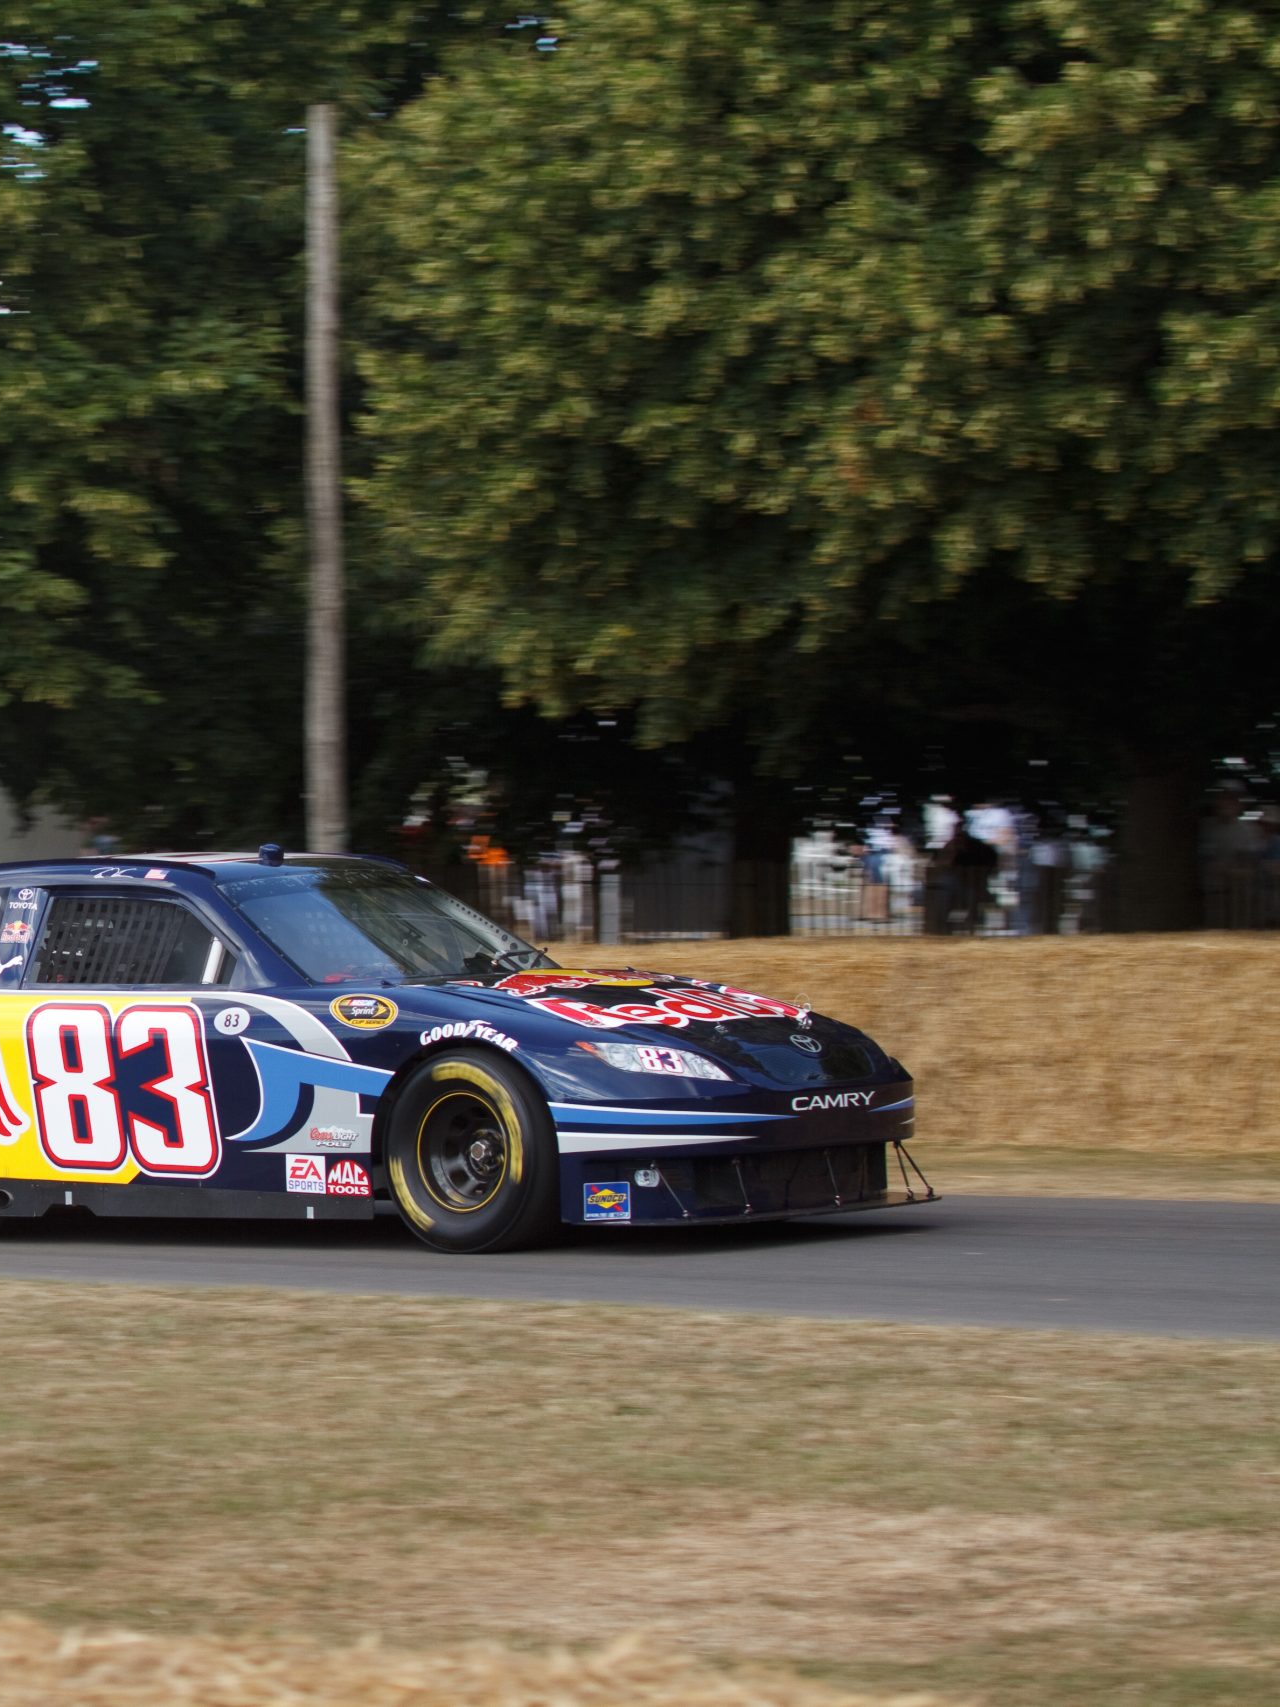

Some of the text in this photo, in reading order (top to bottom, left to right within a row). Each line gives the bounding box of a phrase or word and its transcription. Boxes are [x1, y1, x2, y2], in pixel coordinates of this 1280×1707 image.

[9, 902, 37, 910] TOYOTA
[351, 1007, 375, 1016] Sprint
[224, 1014, 240, 1028] 83
[420, 1020, 518, 1052] GOODYEAR
[636, 1047, 684, 1073] 83
[24, 1002, 222, 1179] 83
[791, 1091, 875, 1111] CAMRY
[289, 1159, 322, 1180] EA
[288, 1180, 324, 1191] SPORTS
[328, 1185, 369, 1195] TOOLS
[589, 1194, 625, 1203] SUNOCO
